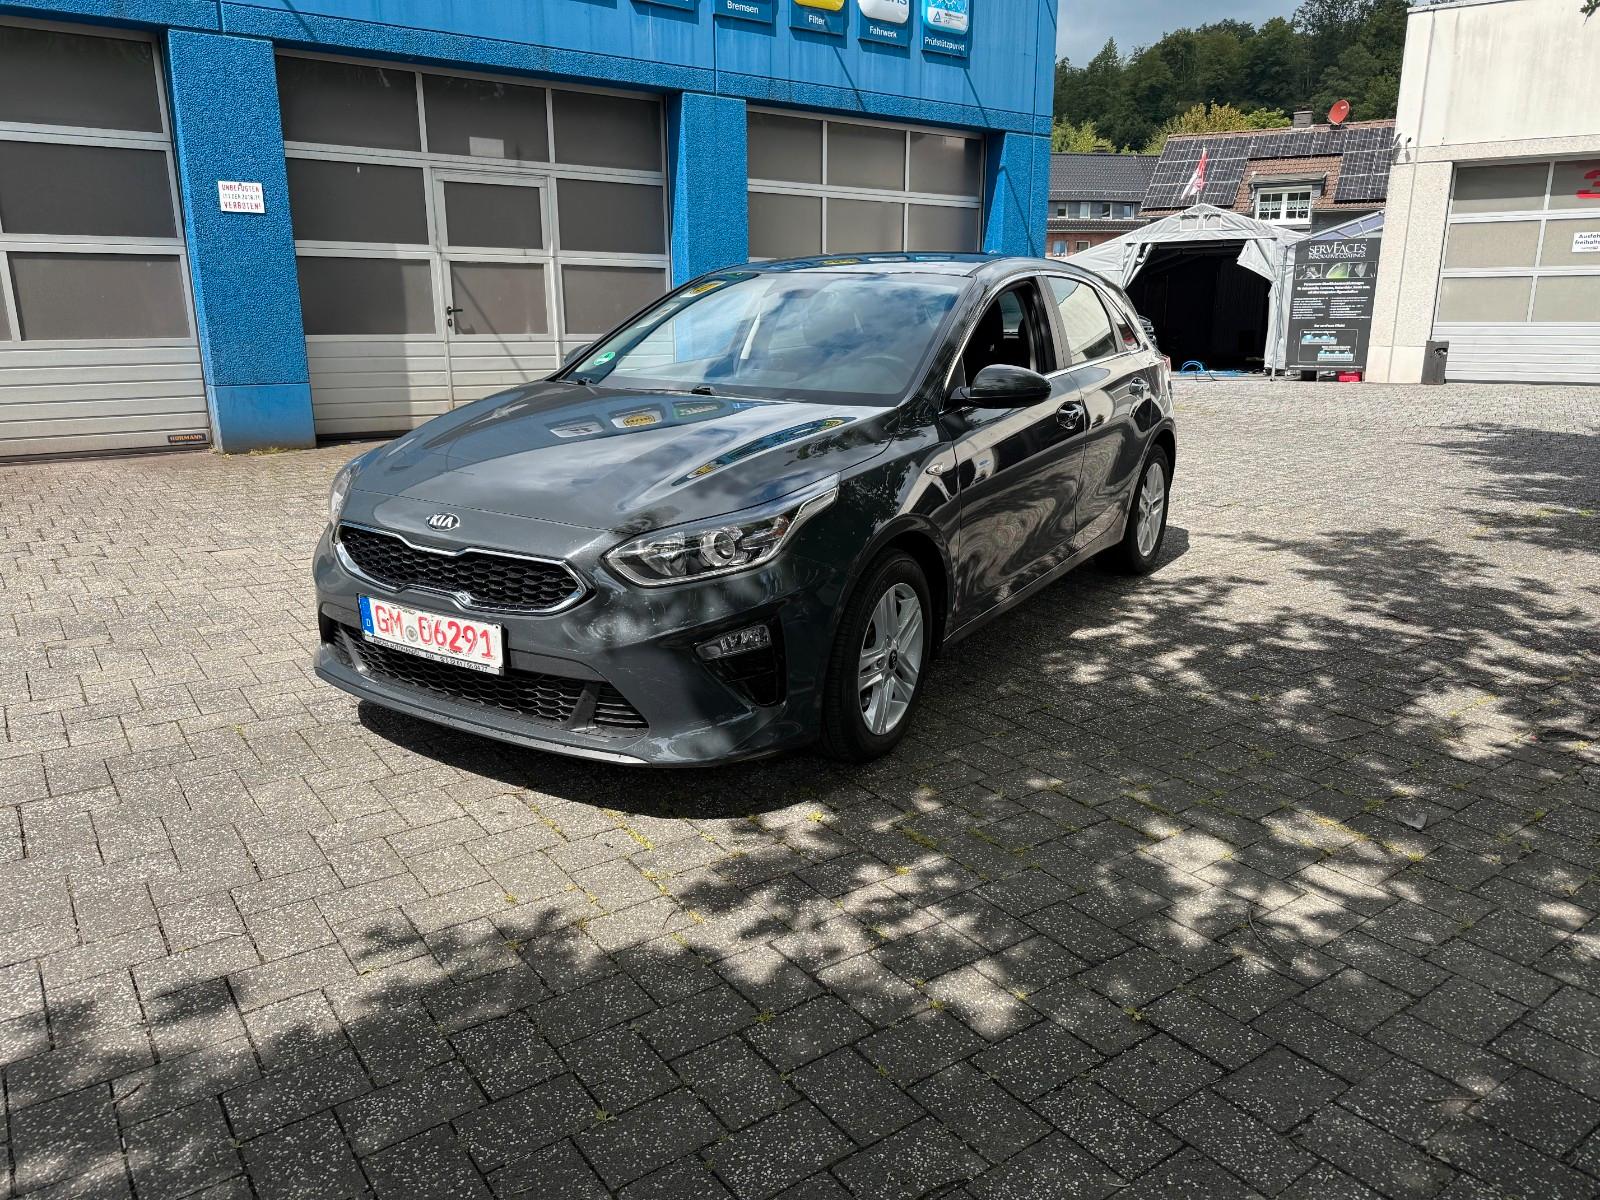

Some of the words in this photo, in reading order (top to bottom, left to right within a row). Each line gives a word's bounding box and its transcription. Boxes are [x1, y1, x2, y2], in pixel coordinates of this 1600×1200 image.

[727, 1, 759, 14] Bremsen
[808, 14, 825, 26] Filter
[869, 25, 897, 38] Fahrwerk
[924, 36, 965, 51] Prüfstützpunkt
[429, 514, 454, 528] KIA
[374, 604, 404, 638] GM
[417, 615, 495, 659] 06291
